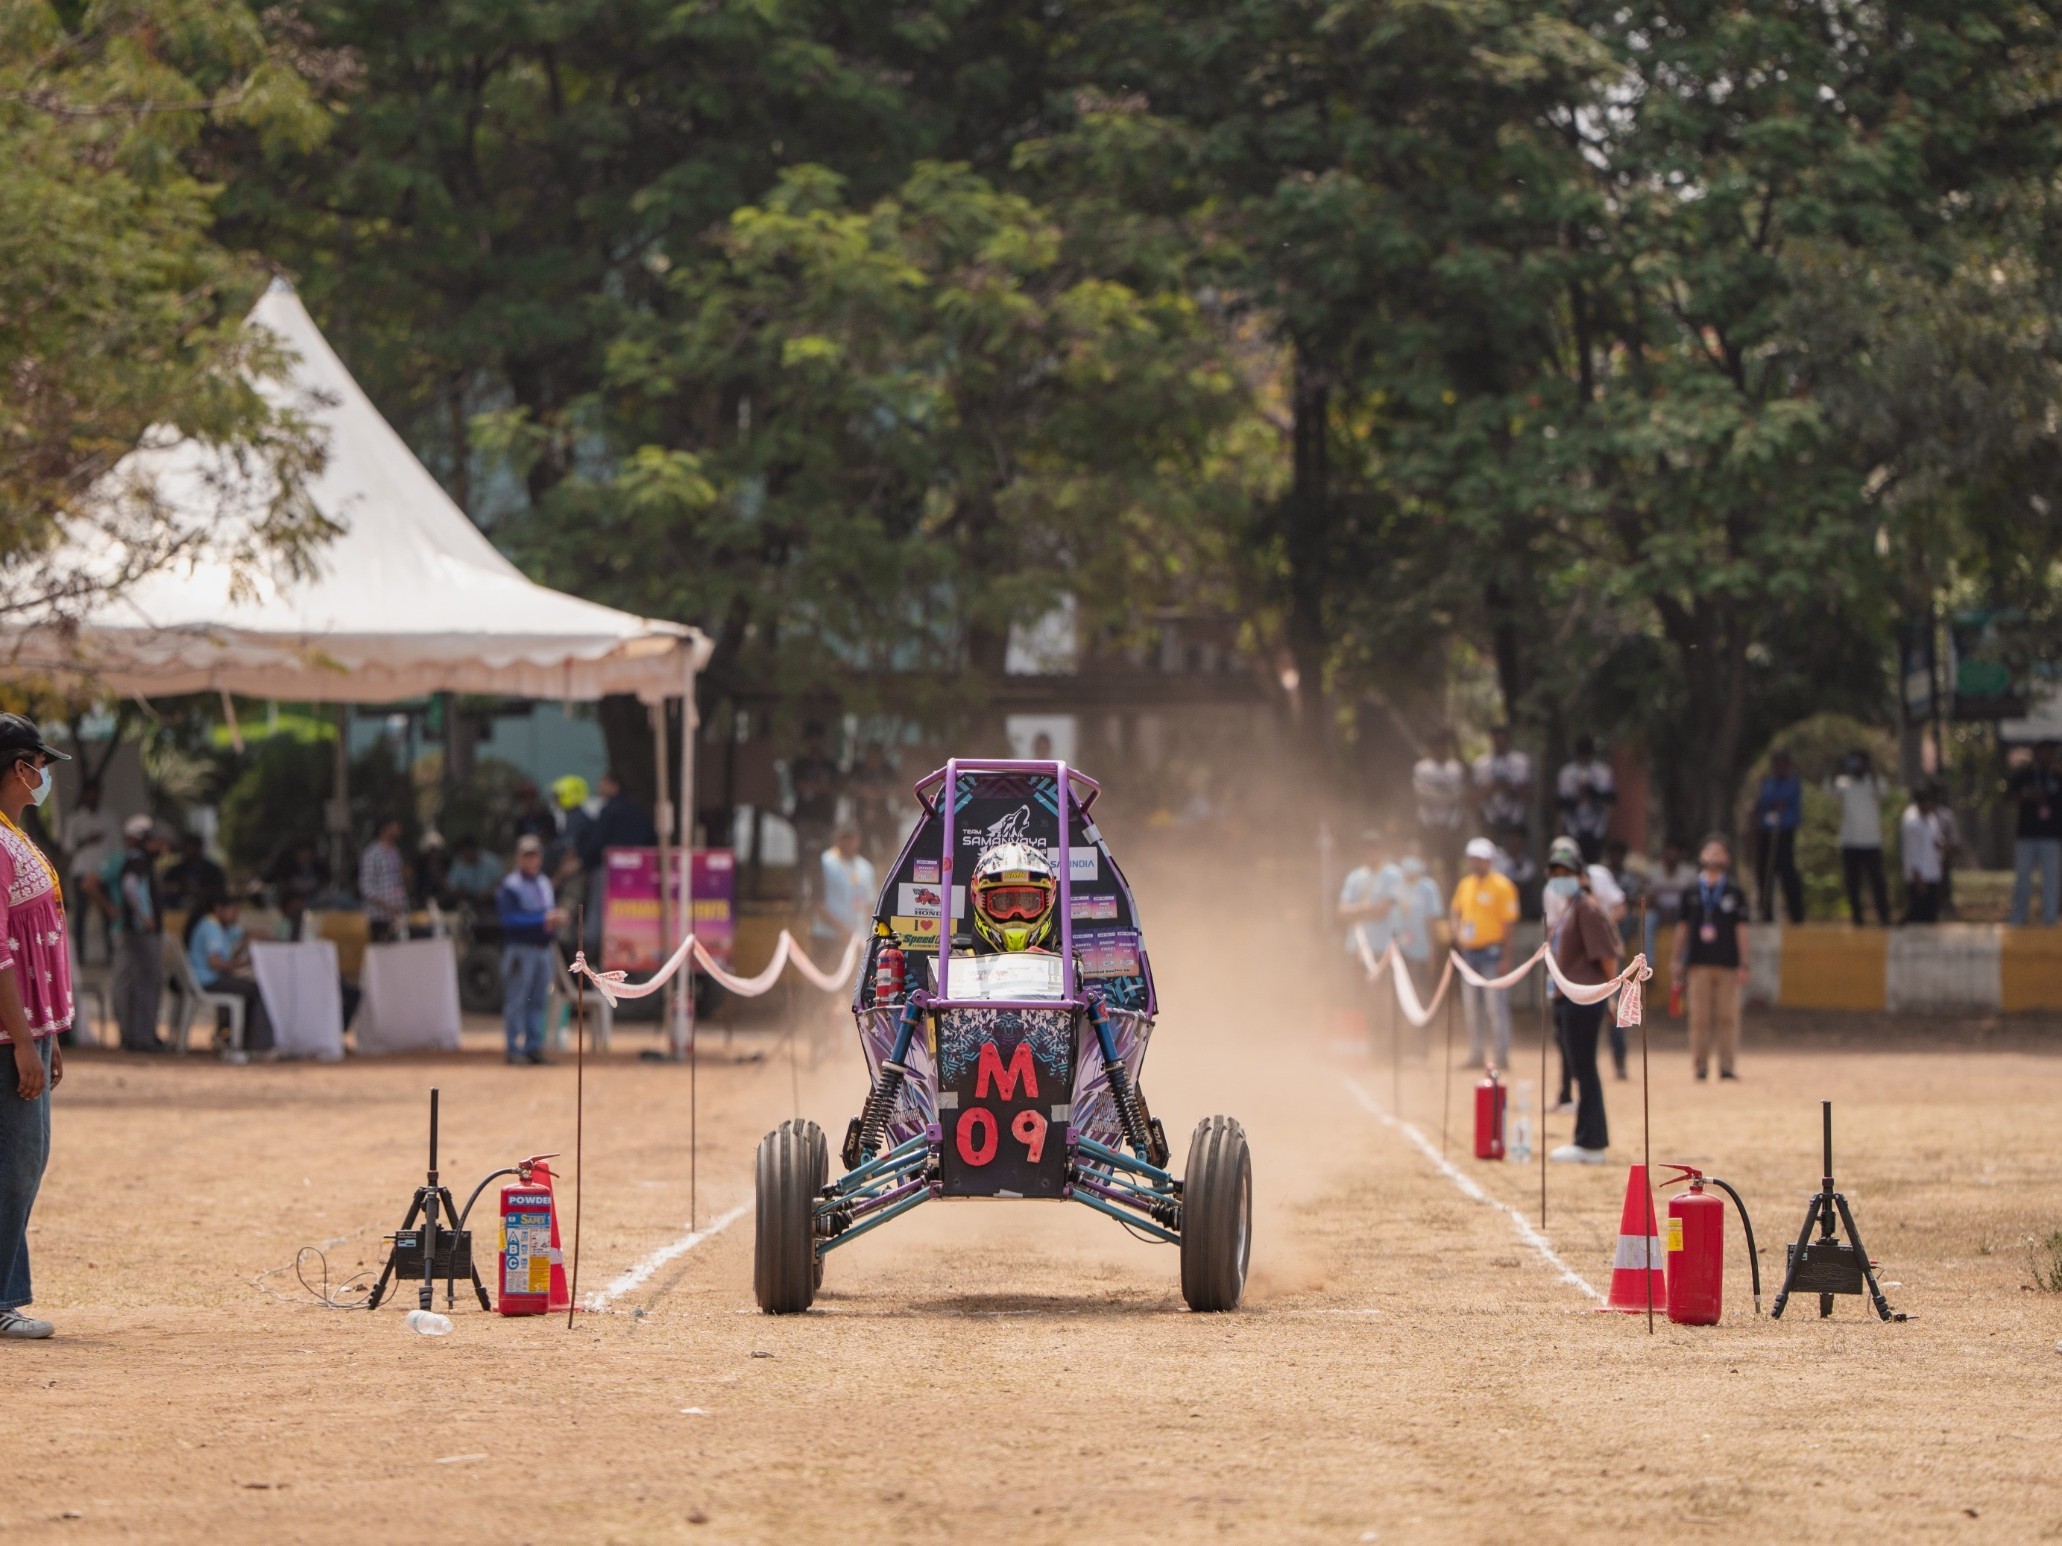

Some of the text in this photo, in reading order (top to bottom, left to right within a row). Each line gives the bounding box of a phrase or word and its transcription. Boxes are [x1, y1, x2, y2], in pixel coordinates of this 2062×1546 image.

[975, 1043, 1039, 1101] M
[957, 1107, 1048, 1167] 09
[508, 1258, 518, 1268] C
[509, 1245, 518, 1254] B
